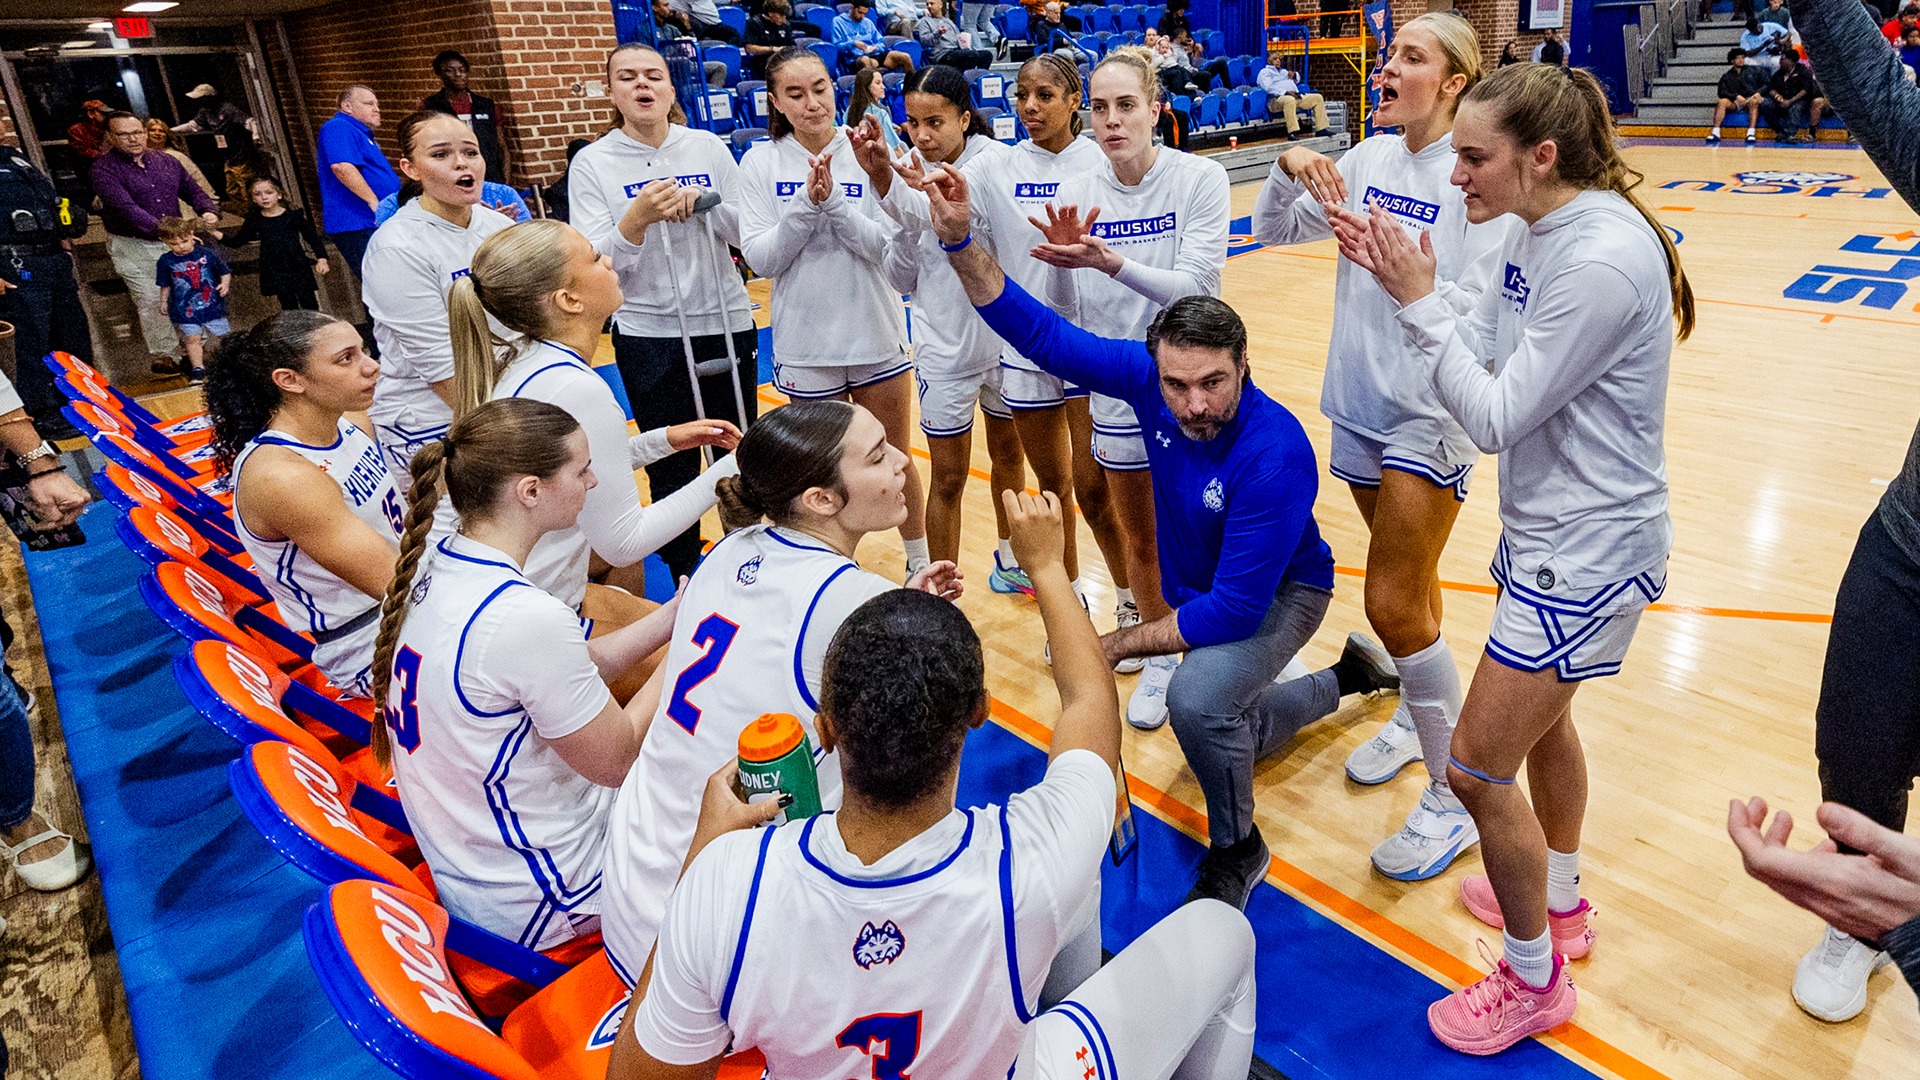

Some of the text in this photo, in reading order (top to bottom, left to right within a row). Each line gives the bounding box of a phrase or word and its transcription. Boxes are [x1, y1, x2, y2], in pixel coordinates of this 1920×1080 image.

[1110, 216, 1174, 236] HUSKIES
[1132, 233, 1175, 245] BASKETALL
[1375, 194, 1436, 220] HUSKIES
[381, 486, 405, 541] 15
[226, 645, 288, 718] HCU
[384, 643, 423, 756] 3
[666, 611, 740, 737] 2
[288, 746, 378, 848] HCU
[372, 887, 497, 1037] HCU
